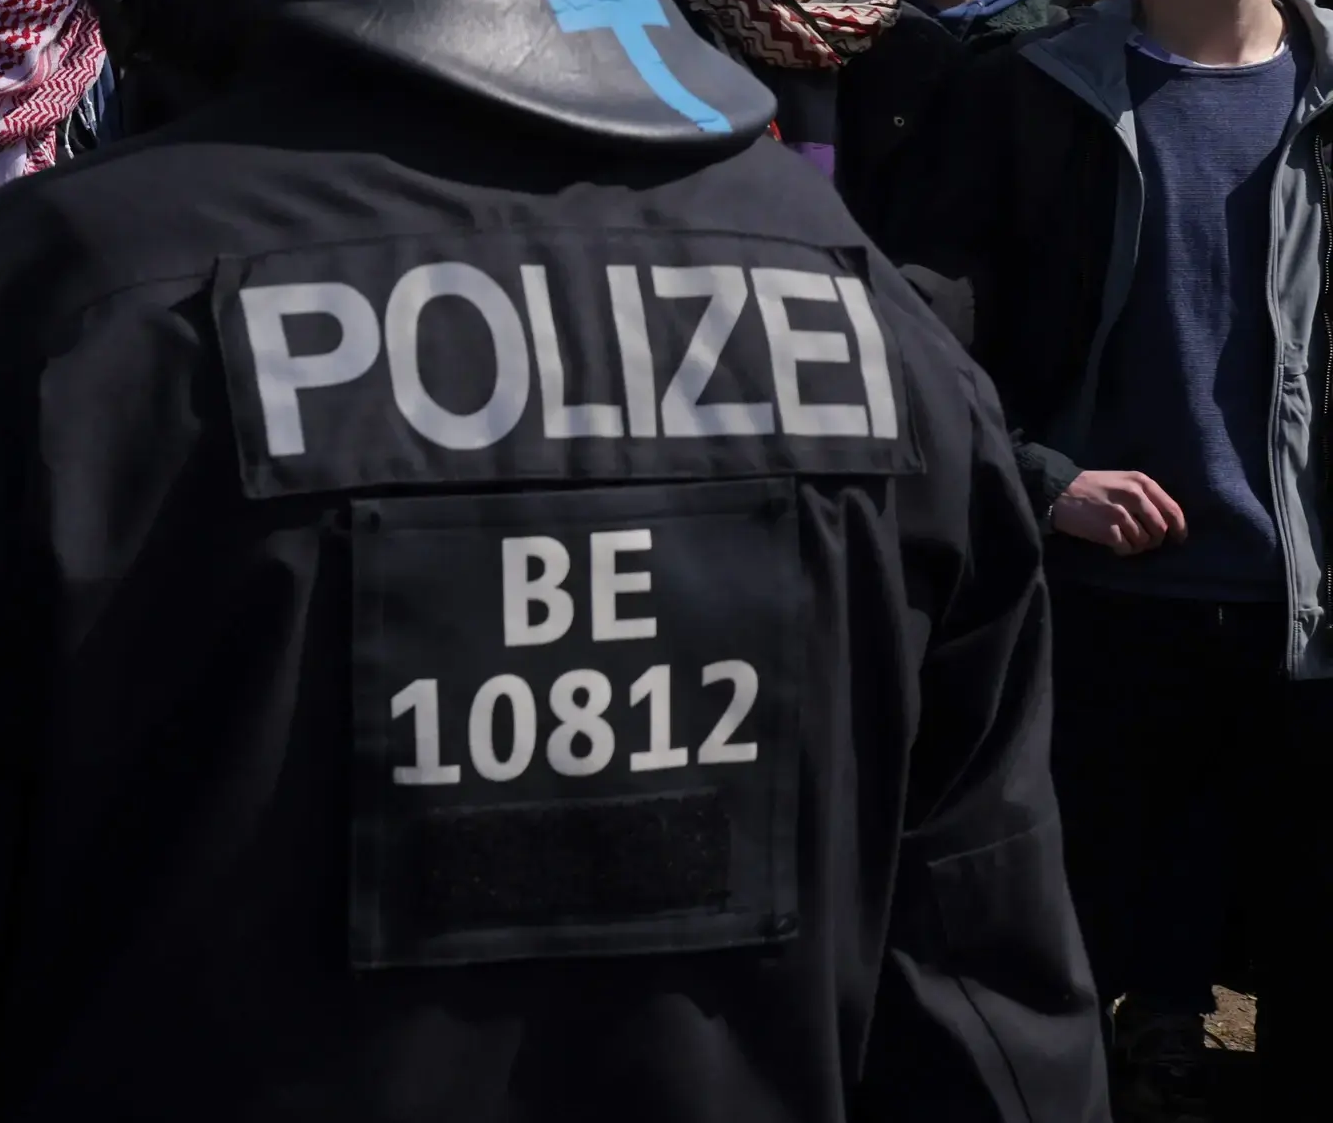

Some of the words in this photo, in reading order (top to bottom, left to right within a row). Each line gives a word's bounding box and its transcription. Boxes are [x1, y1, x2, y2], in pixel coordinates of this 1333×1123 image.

[240, 261, 898, 457] POLIZEI
[501, 529, 657, 647] BE
[389, 659, 760, 786] 10812
